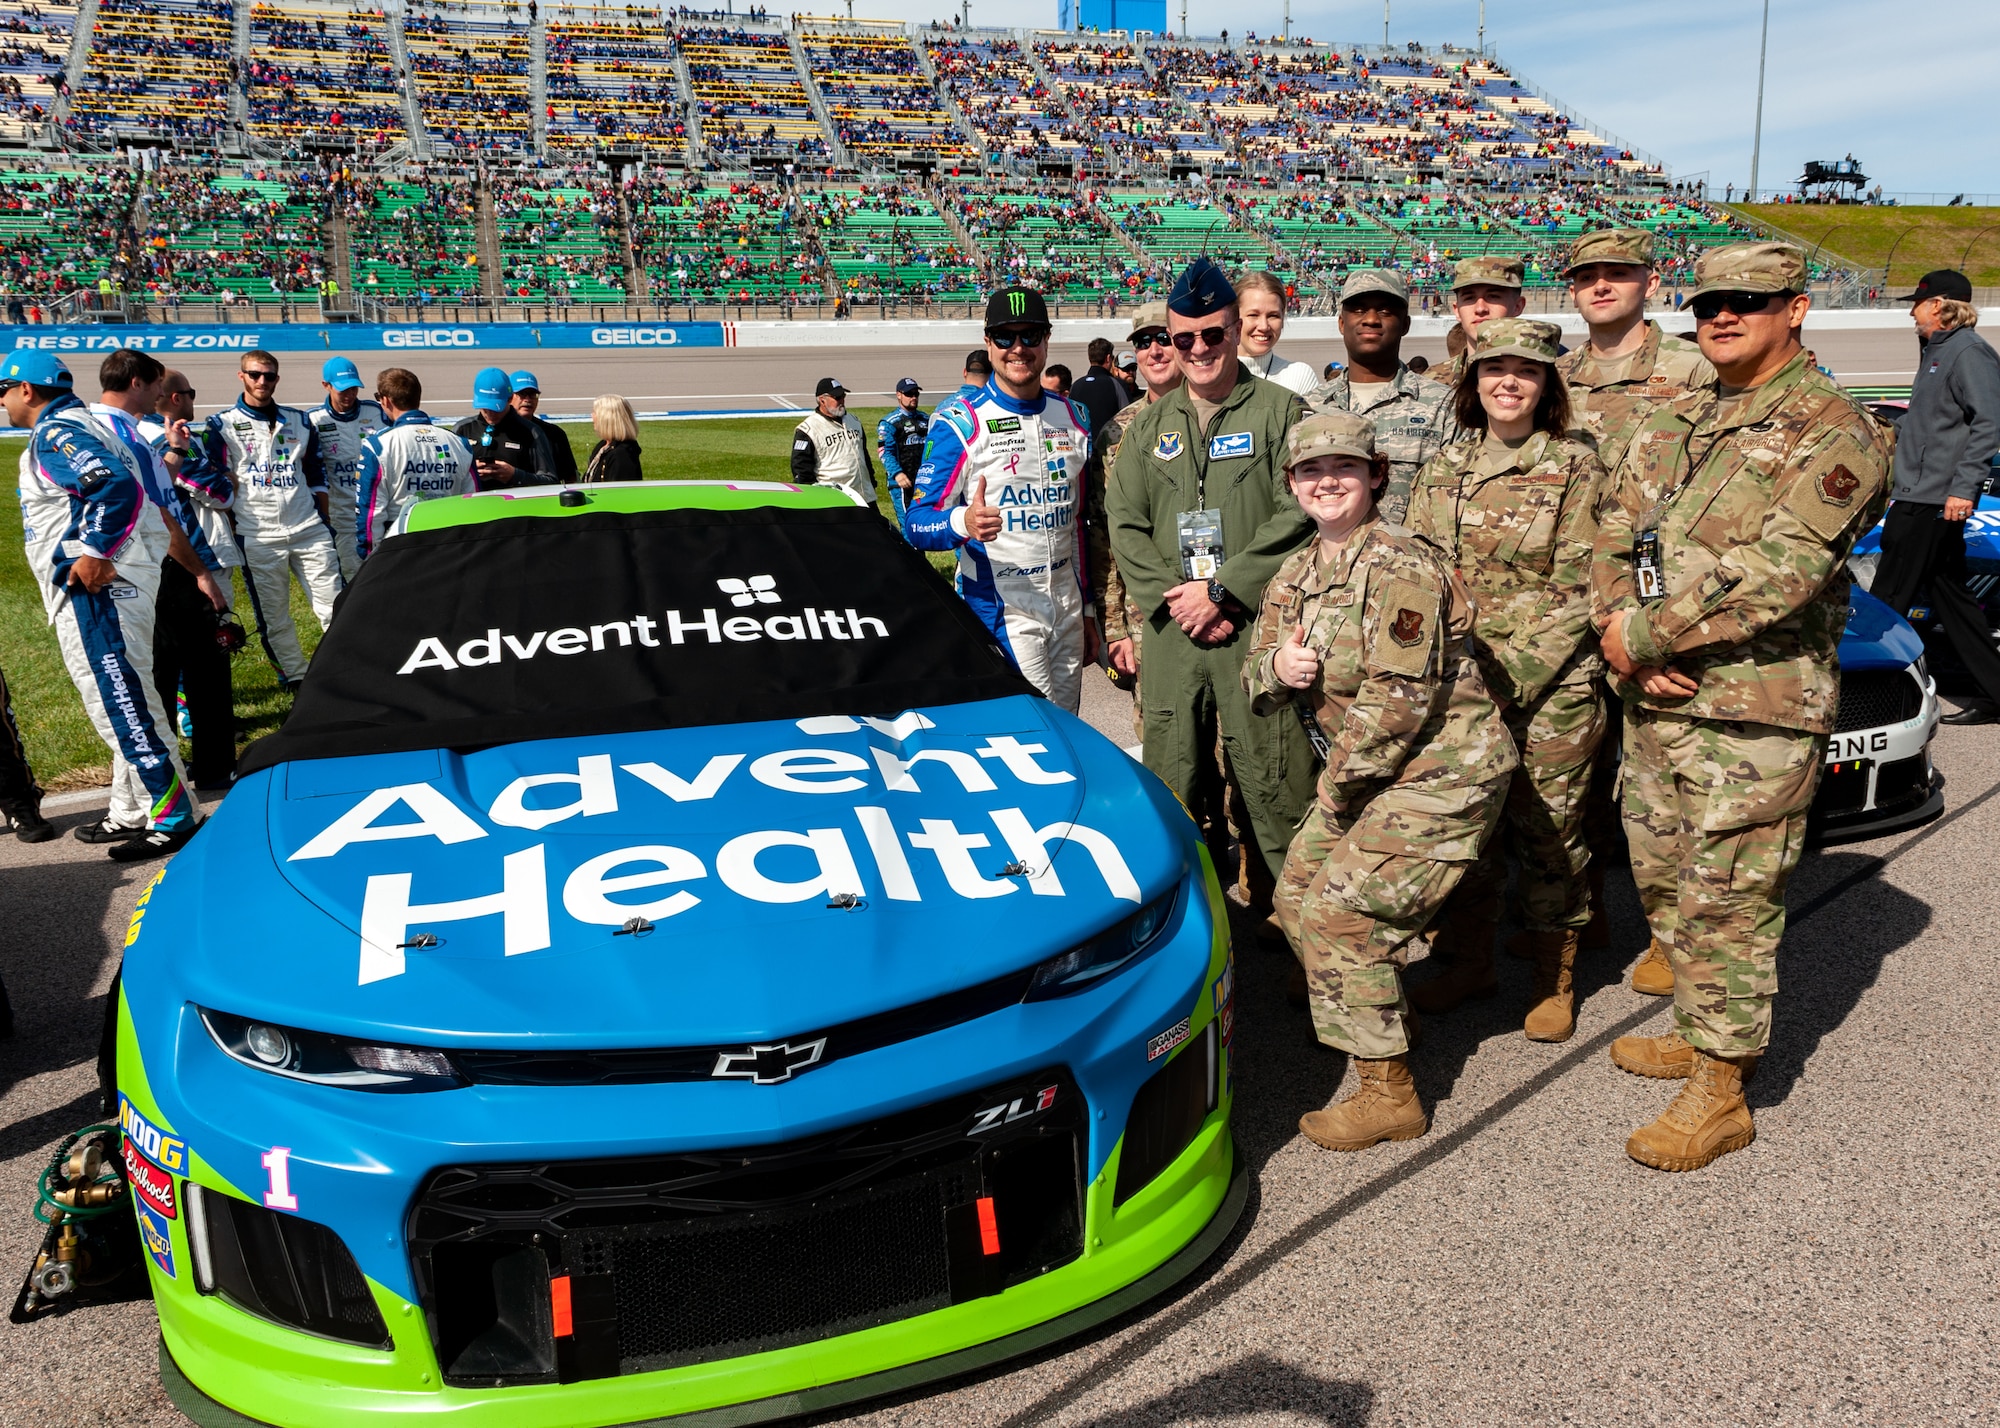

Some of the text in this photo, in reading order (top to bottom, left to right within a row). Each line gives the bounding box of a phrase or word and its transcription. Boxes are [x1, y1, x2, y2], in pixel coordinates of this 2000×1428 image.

[15, 334, 260, 349] RESTART ZONE
[383, 329, 475, 347] GEICO
[592, 328, 678, 345] GEICO
[415, 435, 439, 444] CASE
[247, 460, 297, 474] Advent
[405, 460, 458, 475] Advent
[1000, 483, 1072, 507] Advent
[1007, 508, 1072, 532] Health
[1017, 564, 1047, 576] KURT
[1642, 570, 1654, 595] P
[101, 652, 154, 753] AdventHealth
[287, 735, 1077, 863] Advent
[358, 805, 1141, 986] Health
[1149, 1029, 1190, 1060] RACING
[966, 1083, 1059, 1137] ZL1
[118, 1099, 184, 1171] MOOG
[125, 1149, 173, 1209] Edelbrock
[261, 1145, 299, 1212] 1
